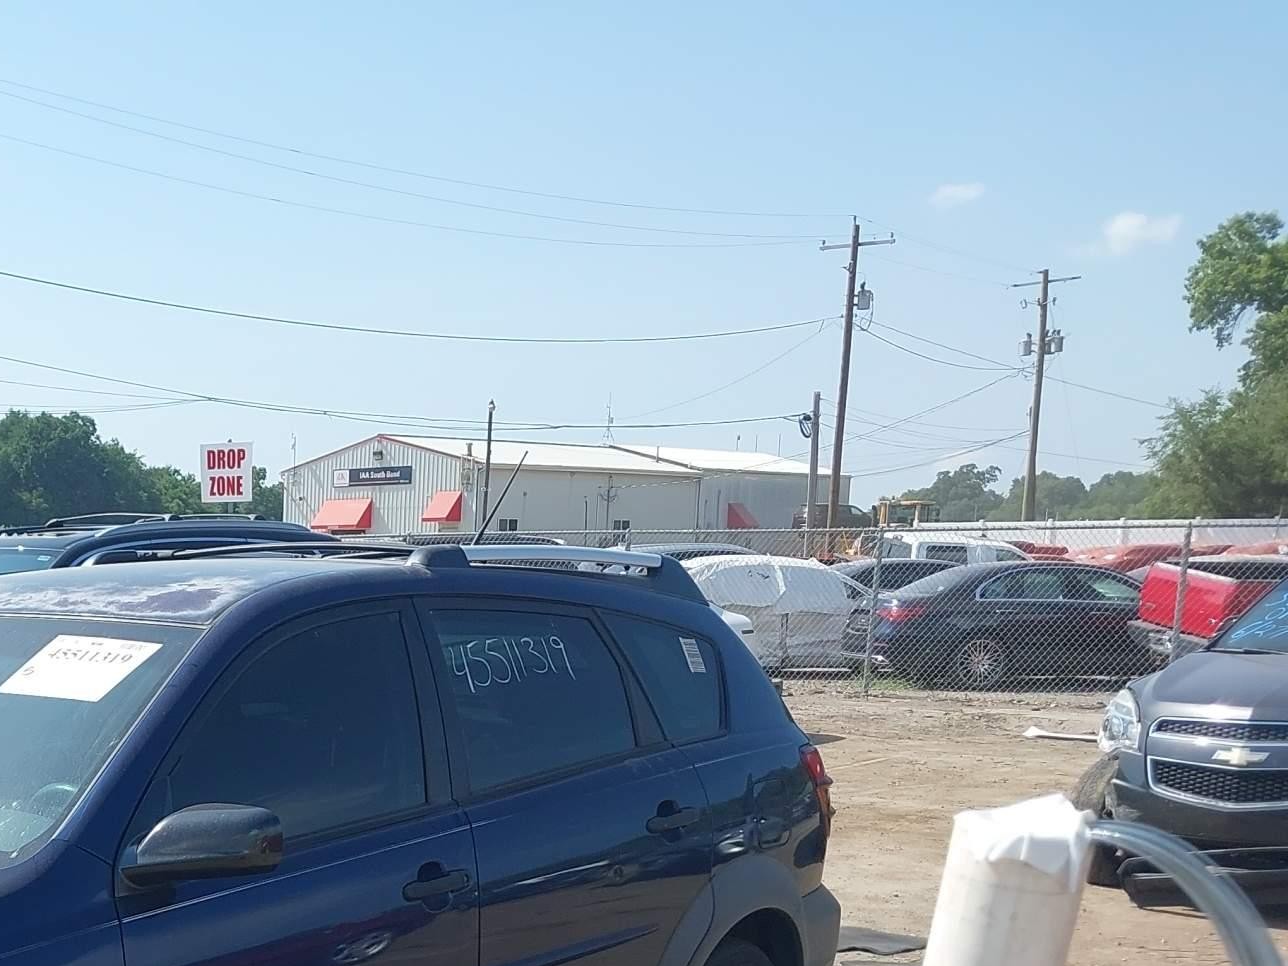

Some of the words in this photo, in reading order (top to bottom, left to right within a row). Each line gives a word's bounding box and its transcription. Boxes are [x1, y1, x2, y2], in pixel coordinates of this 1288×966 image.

[206, 448, 246, 470] DROP
[208, 475, 244, 497] ZONE
[447, 635, 576, 694] 45511319
